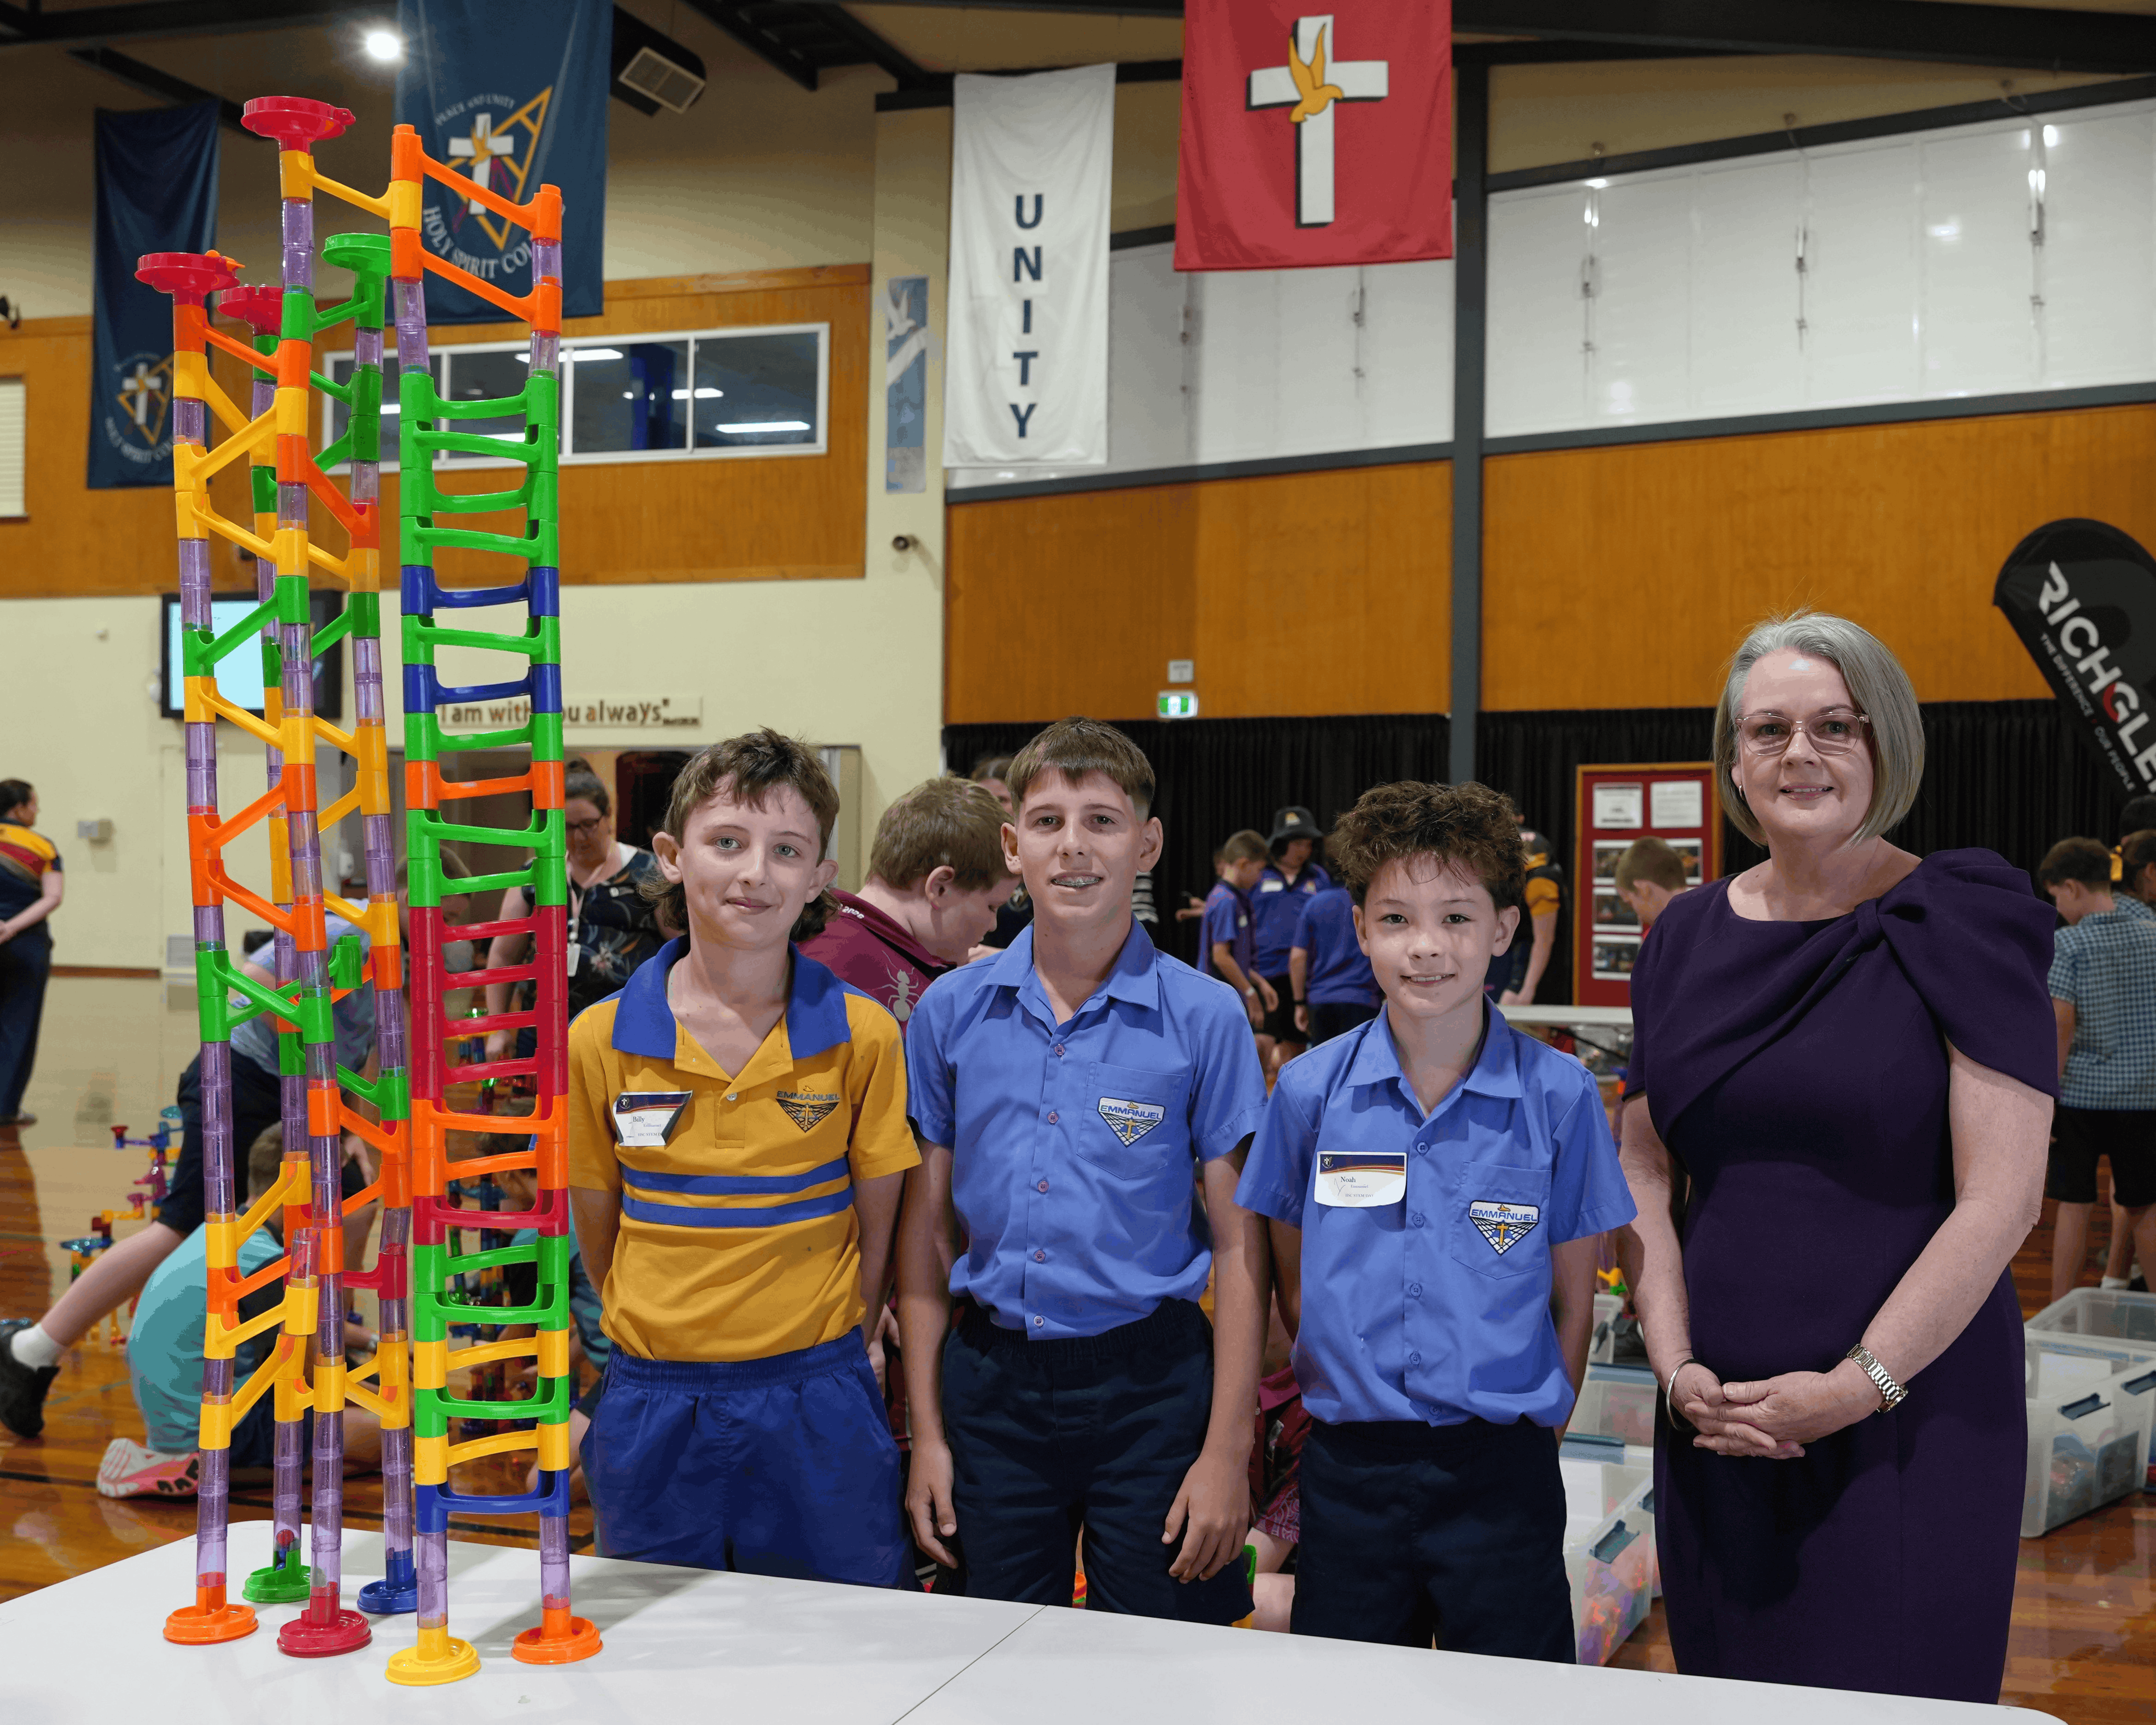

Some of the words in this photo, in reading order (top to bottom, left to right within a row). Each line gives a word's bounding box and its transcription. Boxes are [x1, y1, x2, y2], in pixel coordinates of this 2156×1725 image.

[422, 206, 454, 256] HOLY
[449, 247, 499, 279] SPIRIT
[1010, 194, 1043, 439] UNITY
[2039, 560, 2156, 793] RICHGLE
[452, 706, 483, 723] am
[777, 1090, 840, 1101] EMMANUEL
[1100, 1105, 1162, 1120] EMMANUEL
[1471, 1209, 1537, 1222] EMMANUEL
